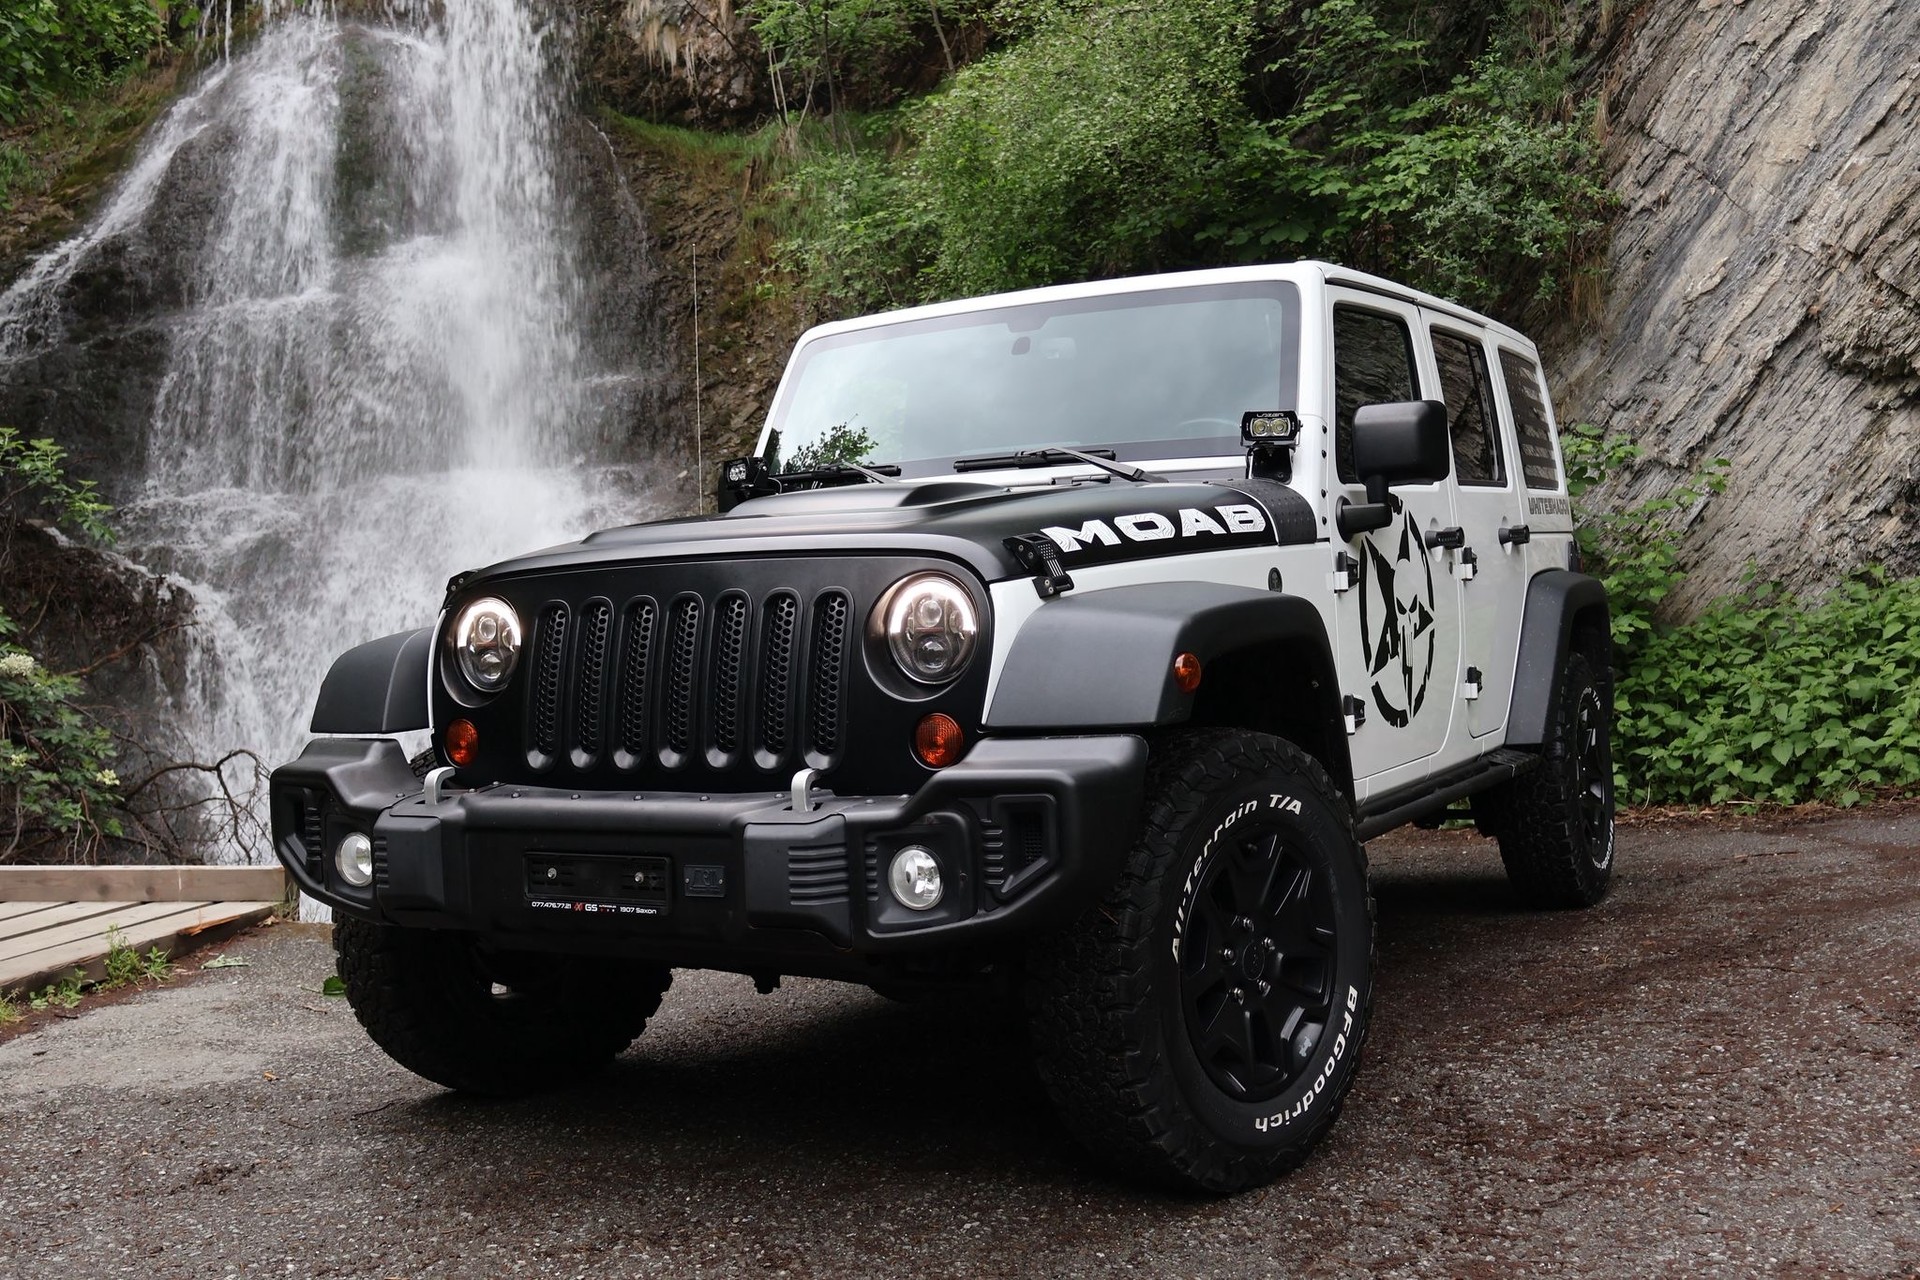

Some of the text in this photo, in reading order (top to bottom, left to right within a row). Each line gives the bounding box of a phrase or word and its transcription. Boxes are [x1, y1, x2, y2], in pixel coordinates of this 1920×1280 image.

[1040, 504, 1266, 553] MOAB
[584, 903, 598, 912] GS
[1171, 794, 1303, 964] All-Terrain T/A
[1255, 985, 1358, 1133] BFGoodrich
